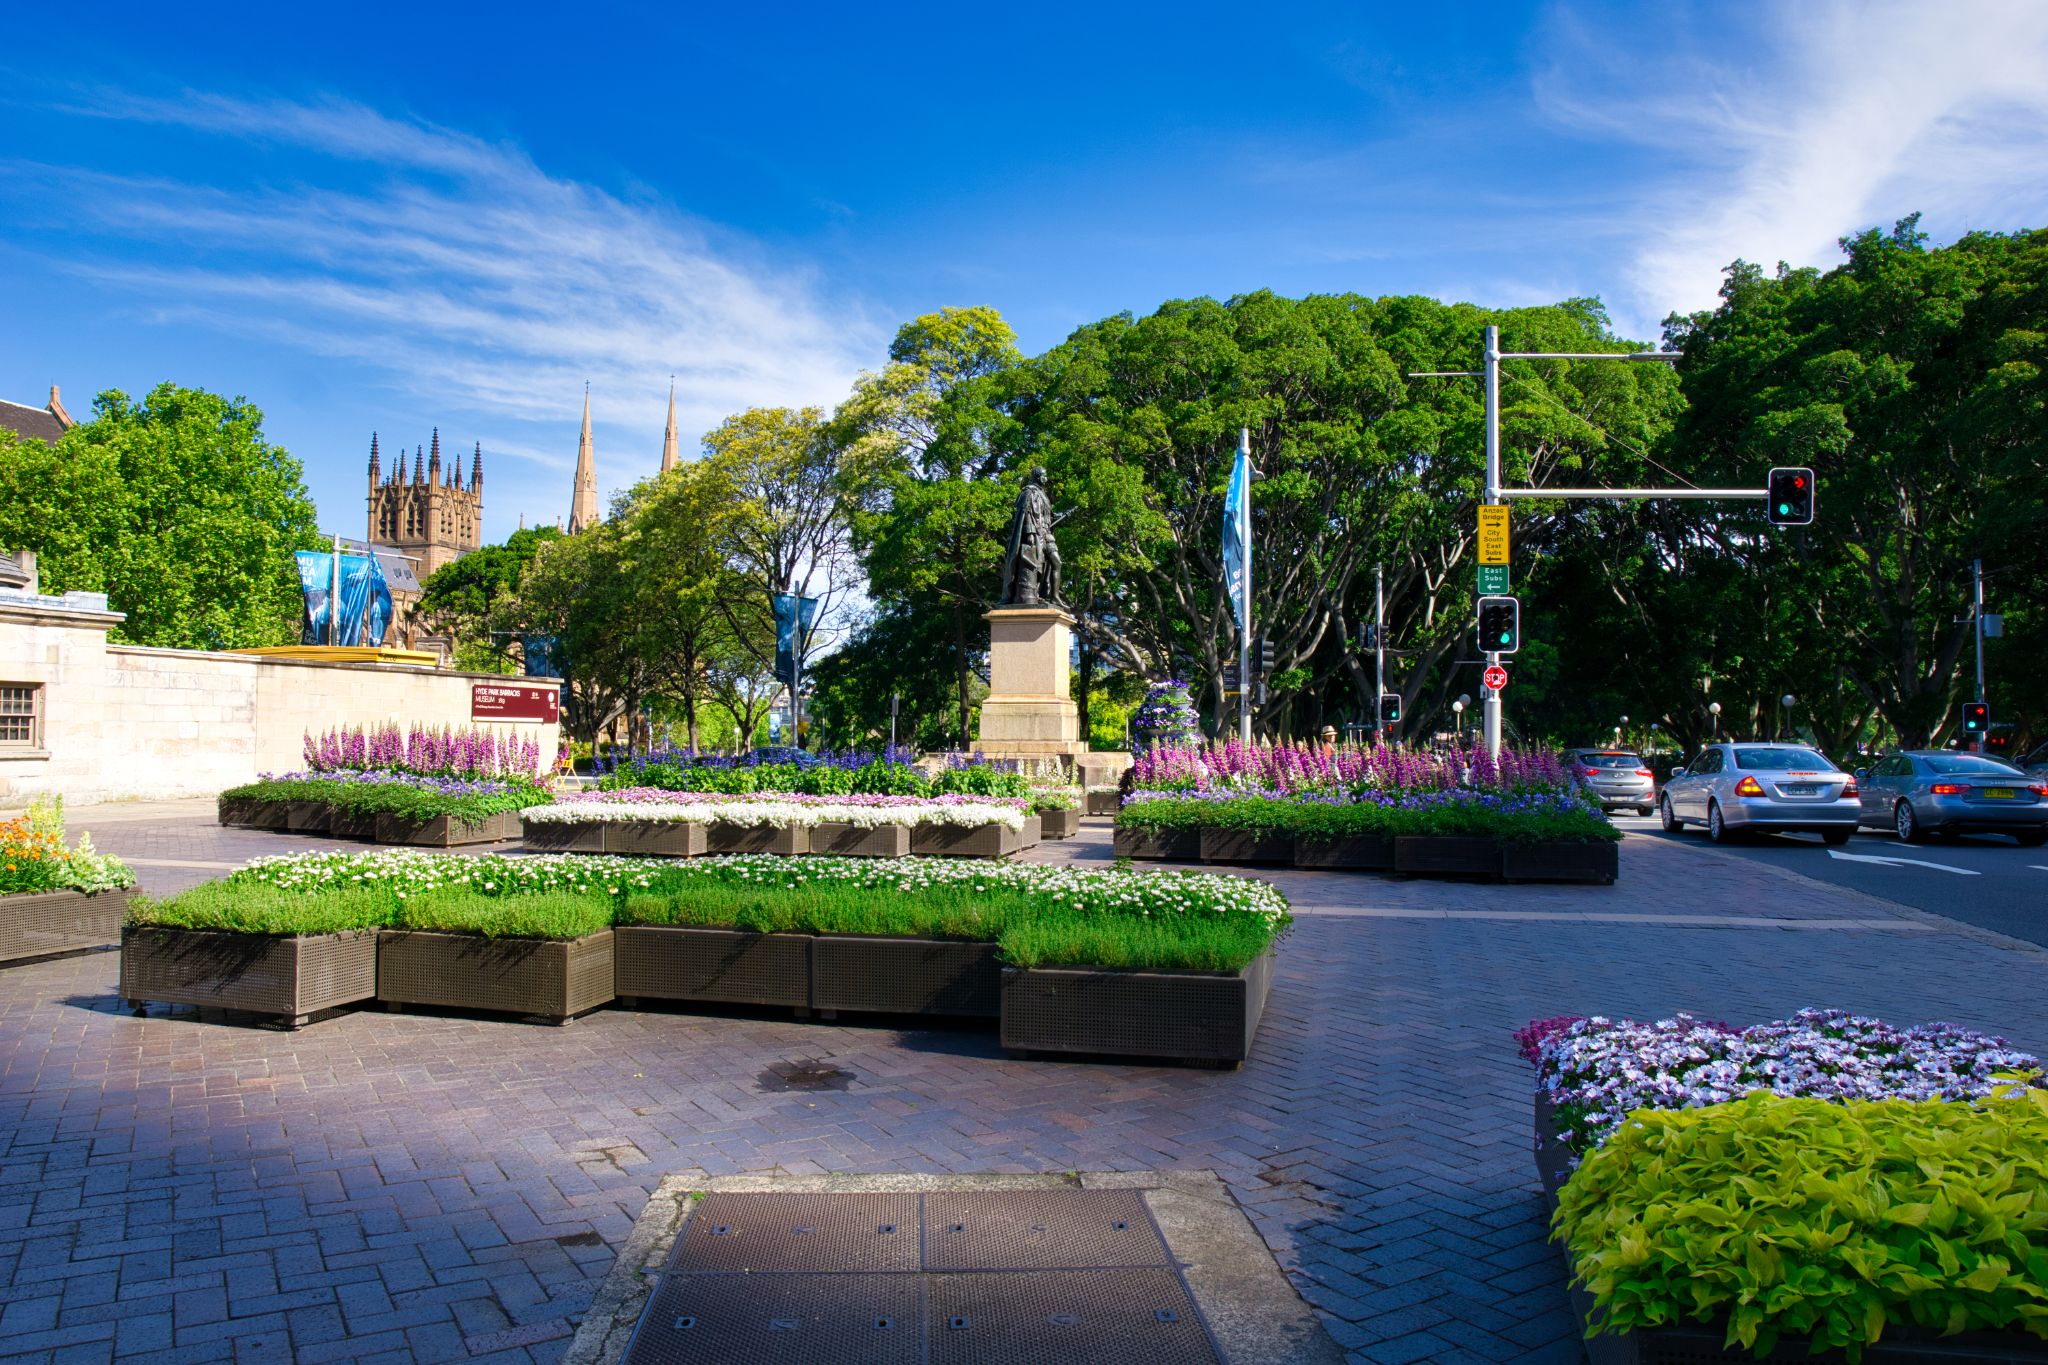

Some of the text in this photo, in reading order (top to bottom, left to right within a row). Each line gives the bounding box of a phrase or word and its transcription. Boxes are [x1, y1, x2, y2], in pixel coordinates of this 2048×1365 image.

[1485, 674, 1504, 682] STOP
[488, 688, 499, 696] PARK
[500, 689, 521, 697] BARRACKS
[475, 695, 495, 703] MUSEUM
